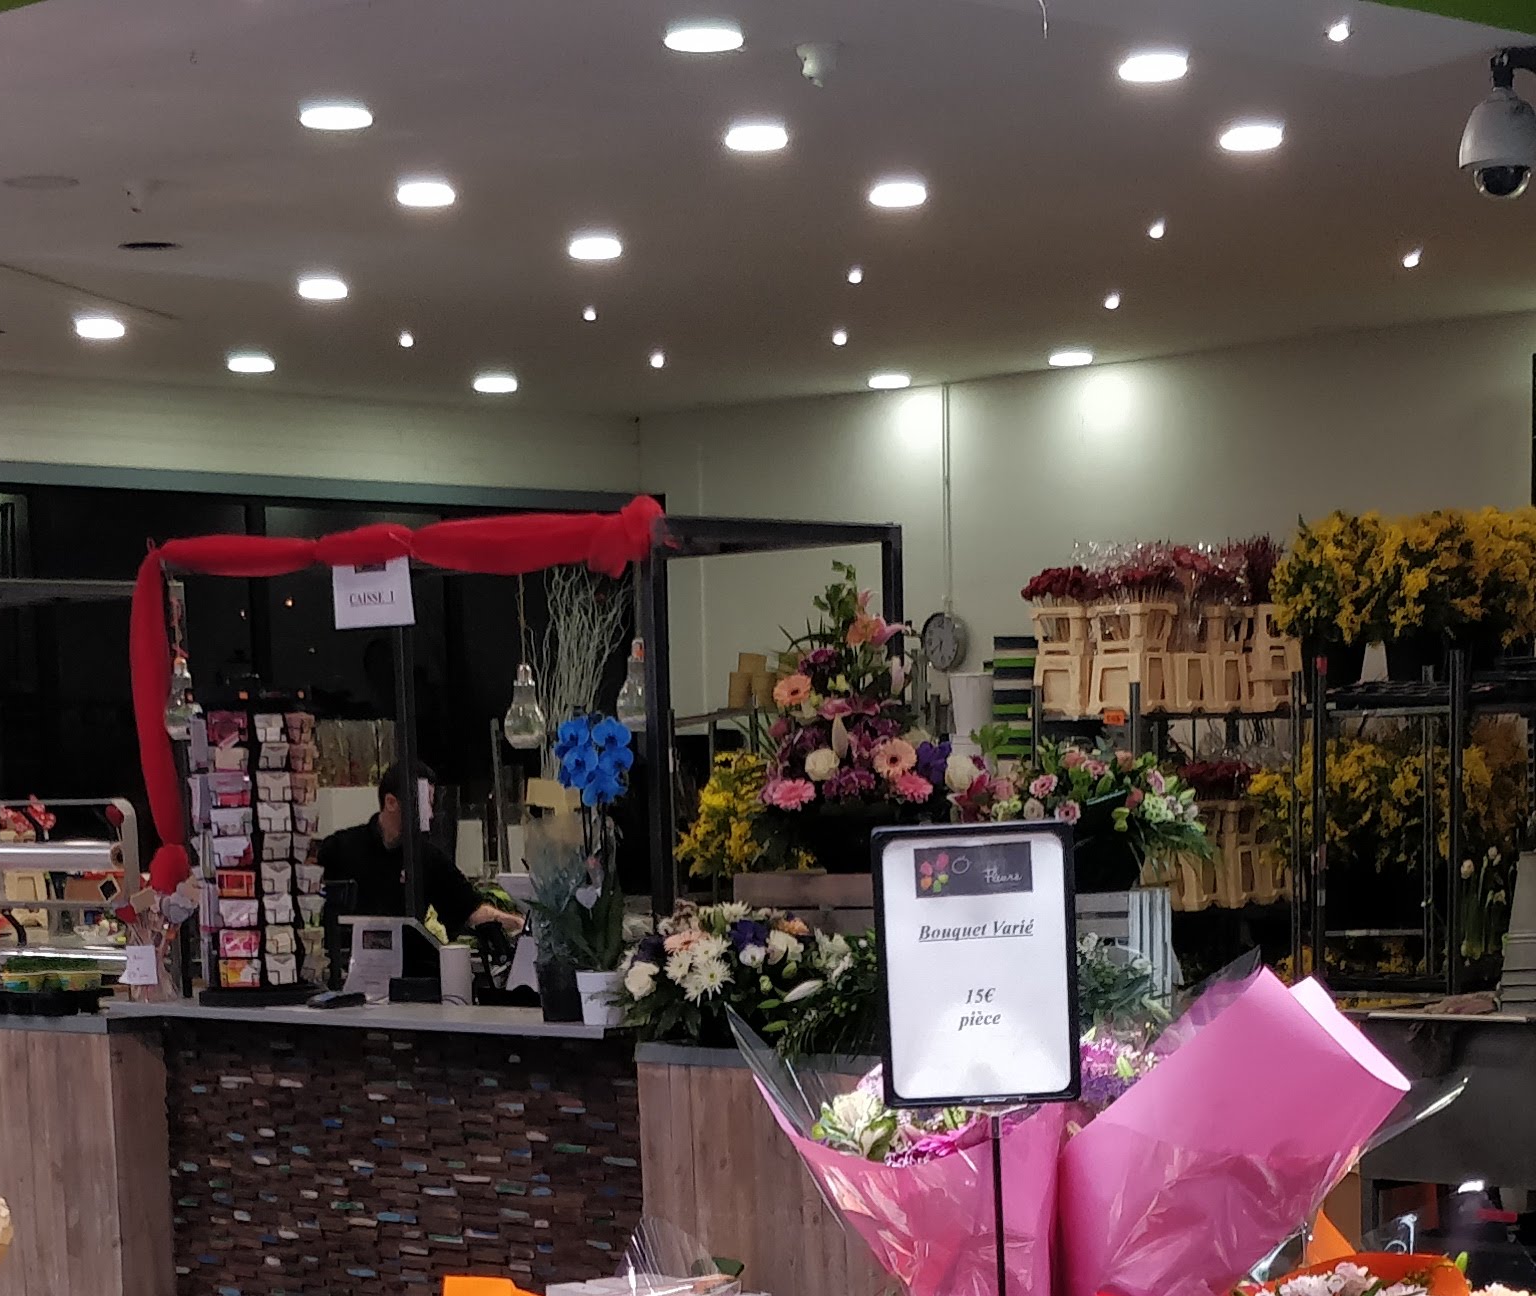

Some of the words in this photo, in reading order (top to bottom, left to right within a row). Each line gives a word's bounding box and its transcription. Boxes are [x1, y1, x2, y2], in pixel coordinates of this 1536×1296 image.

[919, 923, 987, 943] Bouquet
[993, 919, 1035, 938] Varié
[966, 987, 996, 1004] 15€
[958, 1010, 1002, 1031] pièce
